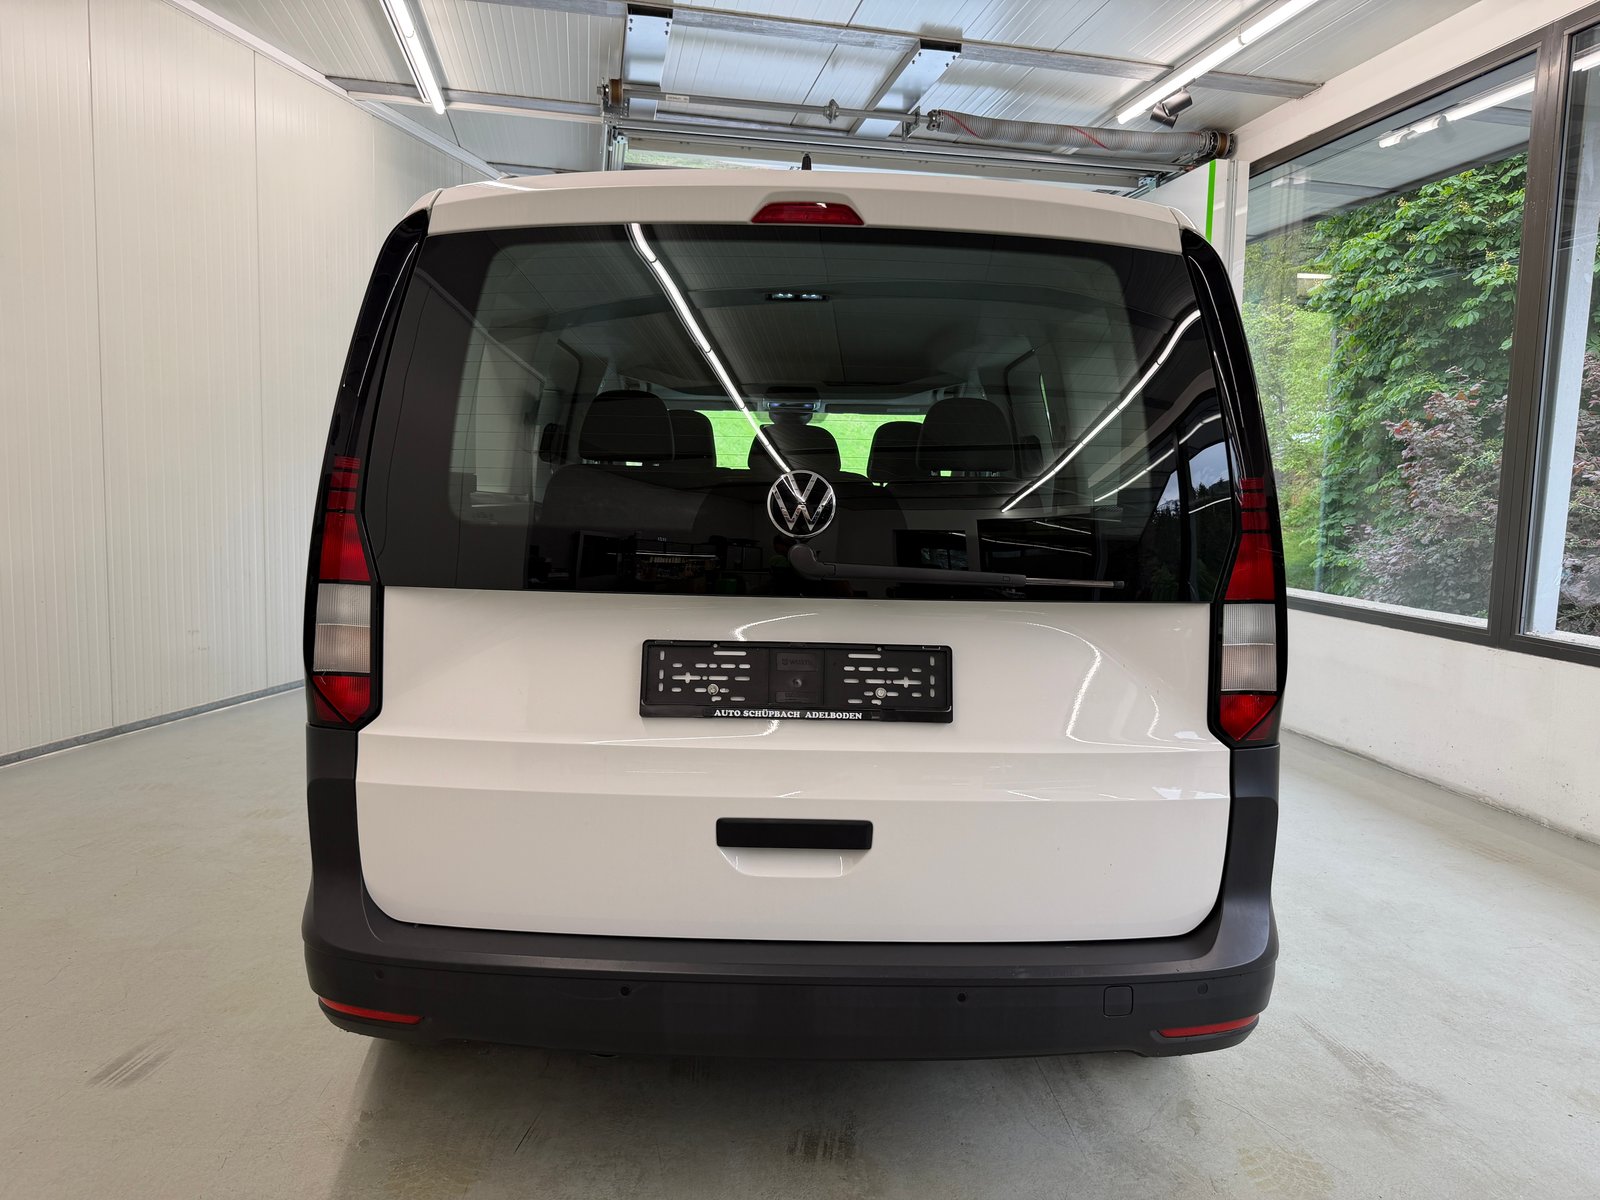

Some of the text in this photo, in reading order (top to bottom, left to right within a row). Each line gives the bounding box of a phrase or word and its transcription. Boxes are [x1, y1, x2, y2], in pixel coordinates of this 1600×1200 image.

[770, 472, 834, 534] VW
[714, 708, 863, 720] AUTO SCHÜPBACH ADELBODEN
